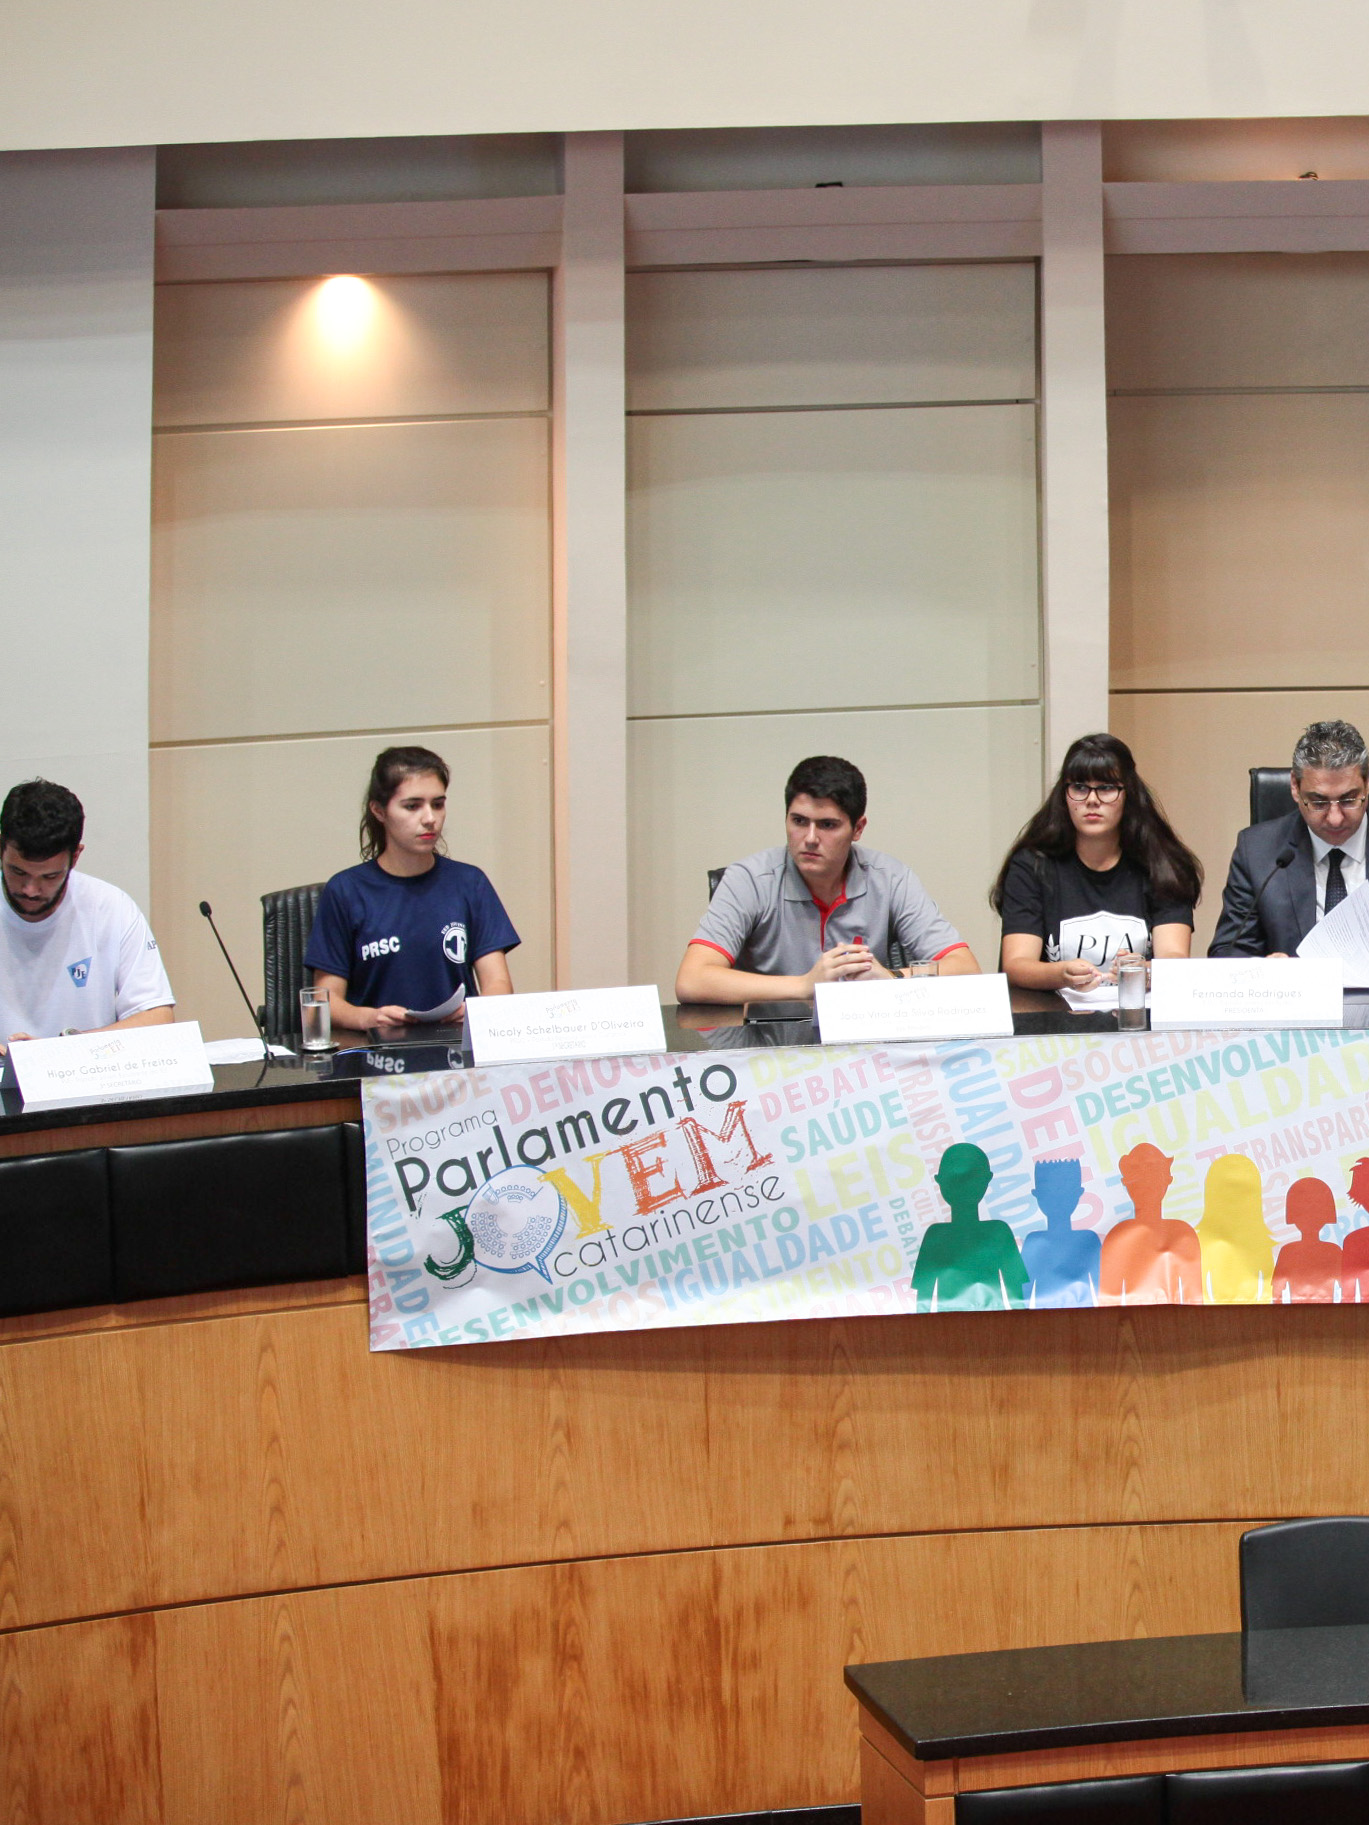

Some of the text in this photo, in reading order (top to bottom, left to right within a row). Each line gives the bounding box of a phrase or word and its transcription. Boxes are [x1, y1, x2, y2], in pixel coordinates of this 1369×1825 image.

[361, 936, 400, 961] PRSC
[1192, 988, 1302, 999] Fernanda Rodrigues
[488, 1027, 521, 1038] Nicoly
[526, 1024, 587, 1036] Schelbauer
[47, 1068, 76, 1079] Higor
[79, 1062, 121, 1076] Gabriel
[124, 1061, 138, 1071] de
[141, 1057, 178, 1069] Freitas
[759, 1052, 897, 1123] DEBATE
[386, 1109, 498, 1160] Programa
[394, 1064, 737, 1213] Parlamento
[780, 1090, 909, 1163] SAÚDE
[793, 1133, 925, 1221] LEIS
[554, 1176, 786, 1278] catarinense
[656, 1202, 888, 1312] IGUALDADE
